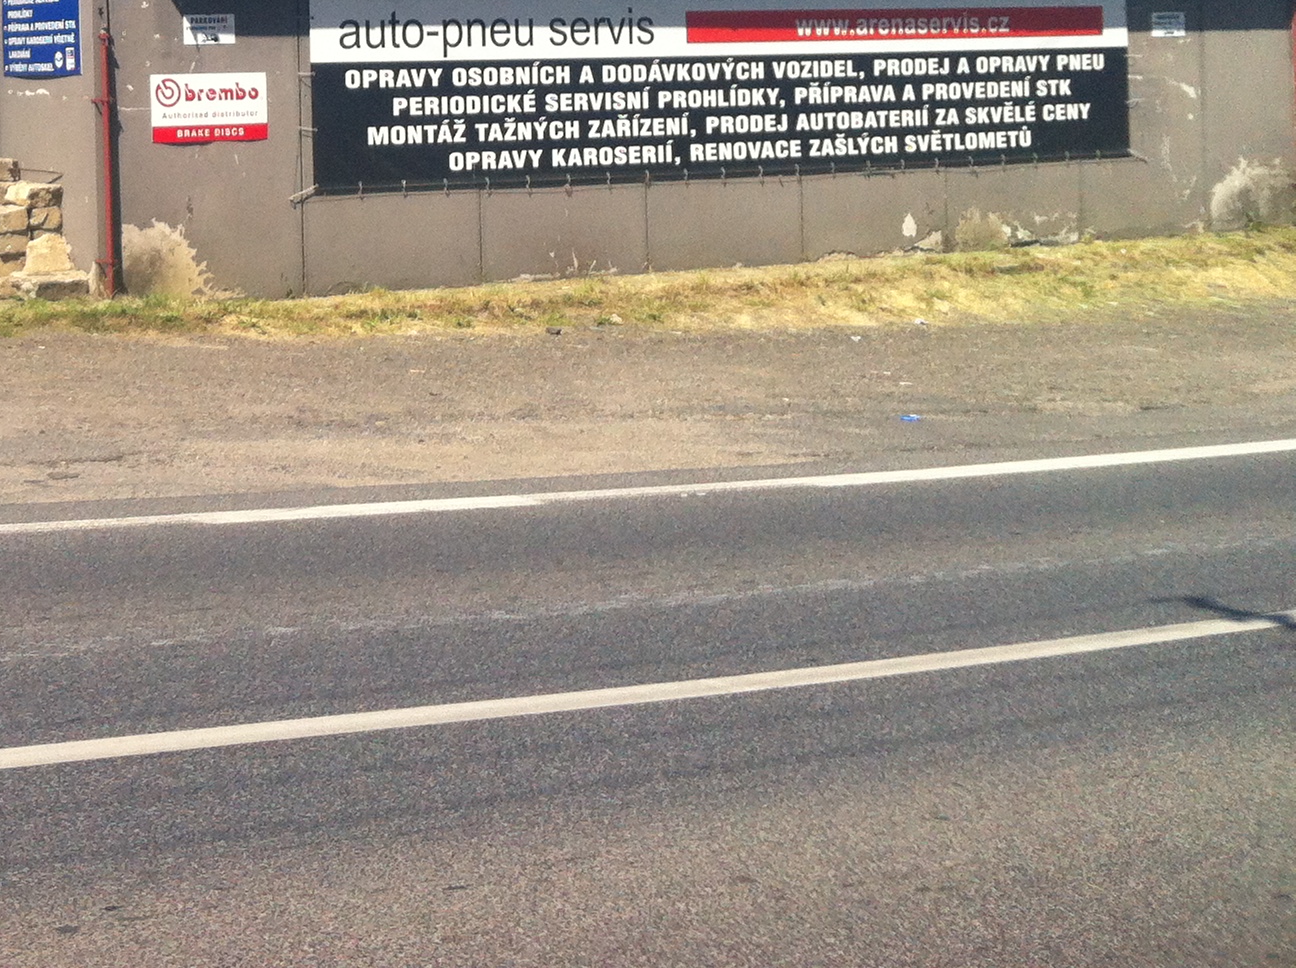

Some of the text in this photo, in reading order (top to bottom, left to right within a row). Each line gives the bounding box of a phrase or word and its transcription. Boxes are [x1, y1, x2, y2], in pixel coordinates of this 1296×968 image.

[338, 7, 655, 58] auto-pneu servis
[795, 12, 1010, 36] www.arenaservis.cz
[344, 53, 1105, 89] OPRAVY OSOBNÍCH A DODÁVKOVÝCH VOZIDEL, PRODEJ A OPRAVY PNEU
[184, 82, 259, 102] brembo
[392, 76, 1072, 116] PERIODICKÉ SERVISNÍ PROHLÍDKY, PŘÍPRAVA A PROVEDENÍ STK
[176, 127, 245, 138] BRAKE DISCS
[367, 100, 1091, 145] MONTÁŽ TAŽNÝCH ZAŘÍZENÍ, PRODEJ AUTOBATERIÍ ZA SKVĚLÉ CENY
[449, 125, 1032, 171] OPRAVY KAROSERIÍ, RENOVACE ZAŠLÝCH SVĚTLOMETŮ
